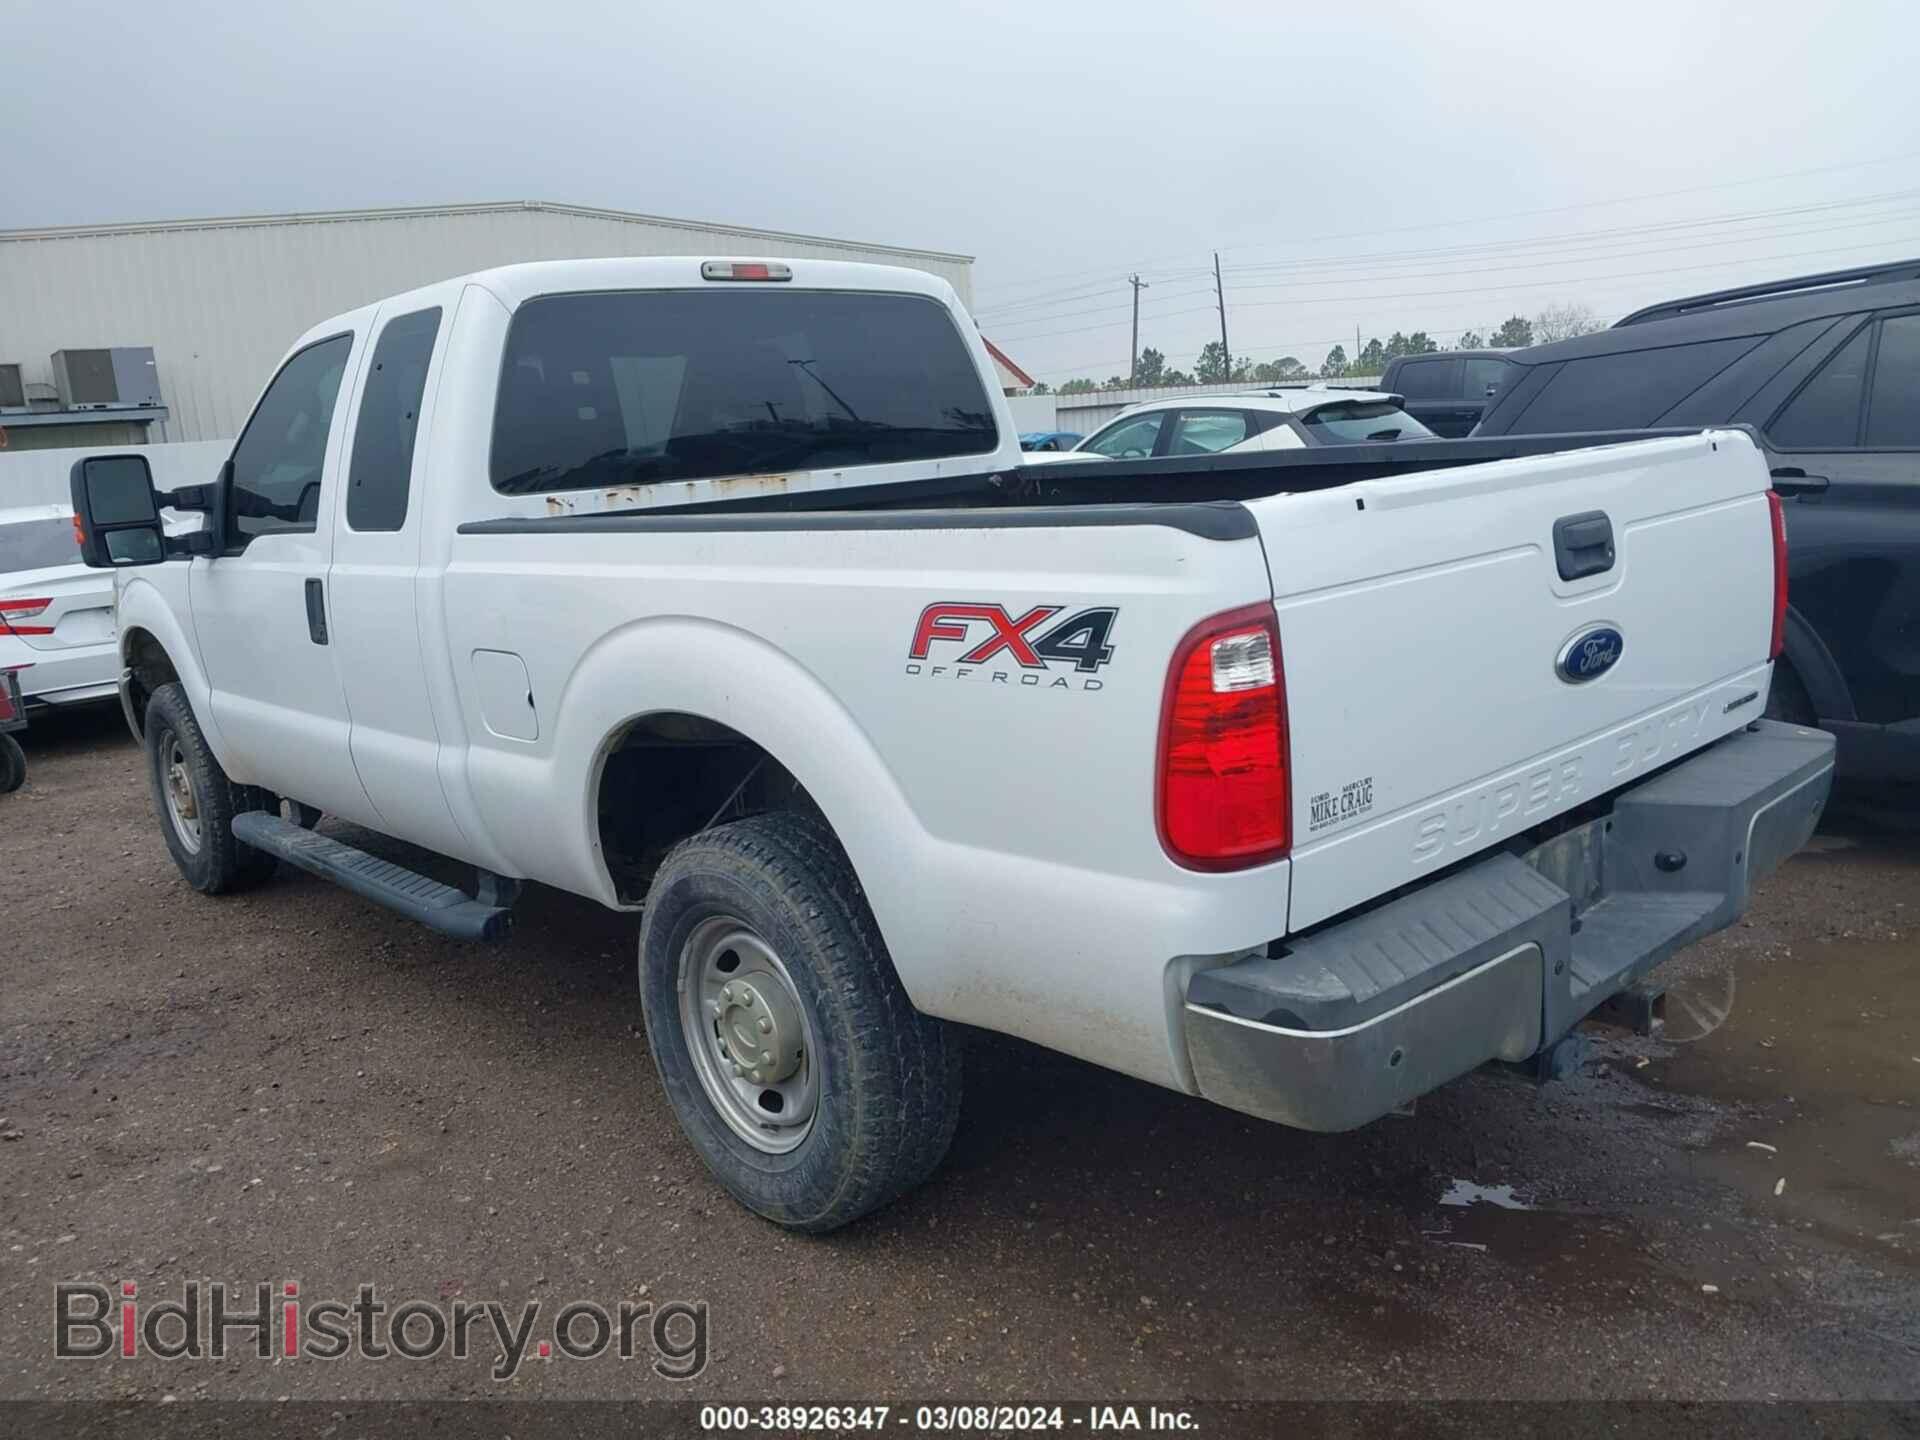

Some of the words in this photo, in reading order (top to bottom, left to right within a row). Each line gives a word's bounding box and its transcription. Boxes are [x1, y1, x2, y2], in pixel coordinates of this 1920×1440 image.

[908, 601, 1120, 673] FX4
[1580, 638, 1620, 673] Ford
[905, 664, 973, 680] OFF
[991, 671, 1104, 691] ROAD
[1410, 756, 1585, 864] SUPER
[1611, 699, 1711, 777] DUTY
[1310, 797, 1338, 825] MIKE
[1341, 784, 1373, 813] CRAIG
